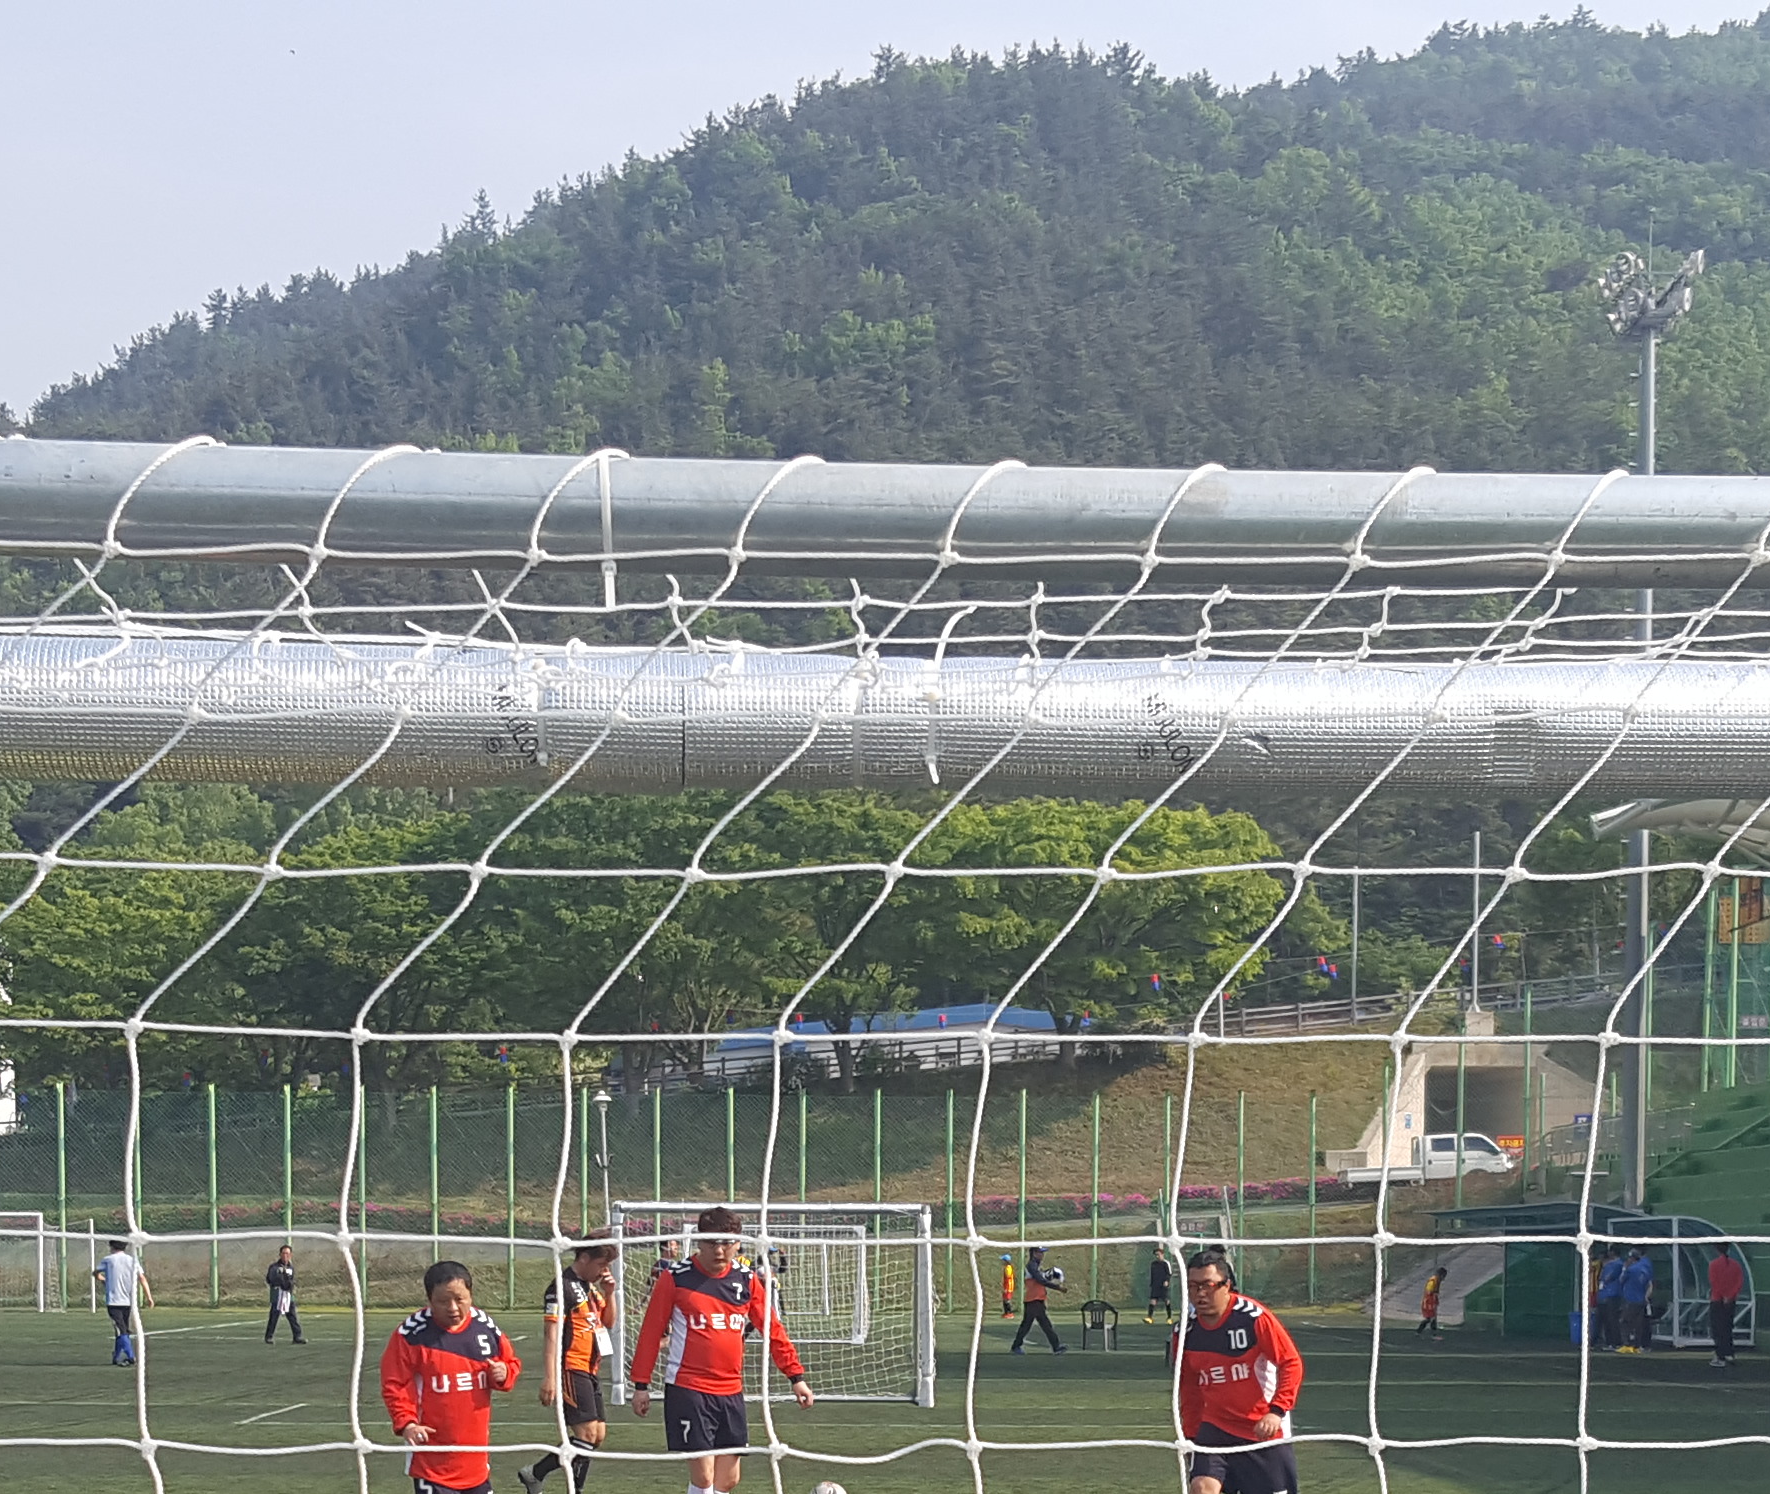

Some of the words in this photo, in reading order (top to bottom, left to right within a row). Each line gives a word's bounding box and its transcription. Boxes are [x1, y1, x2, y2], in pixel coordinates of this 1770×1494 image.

[731, 1282, 743, 1300] 7
[478, 1334, 492, 1355] 5
[1227, 1328, 1248, 1350] 10
[680, 1420, 691, 1443] 7
